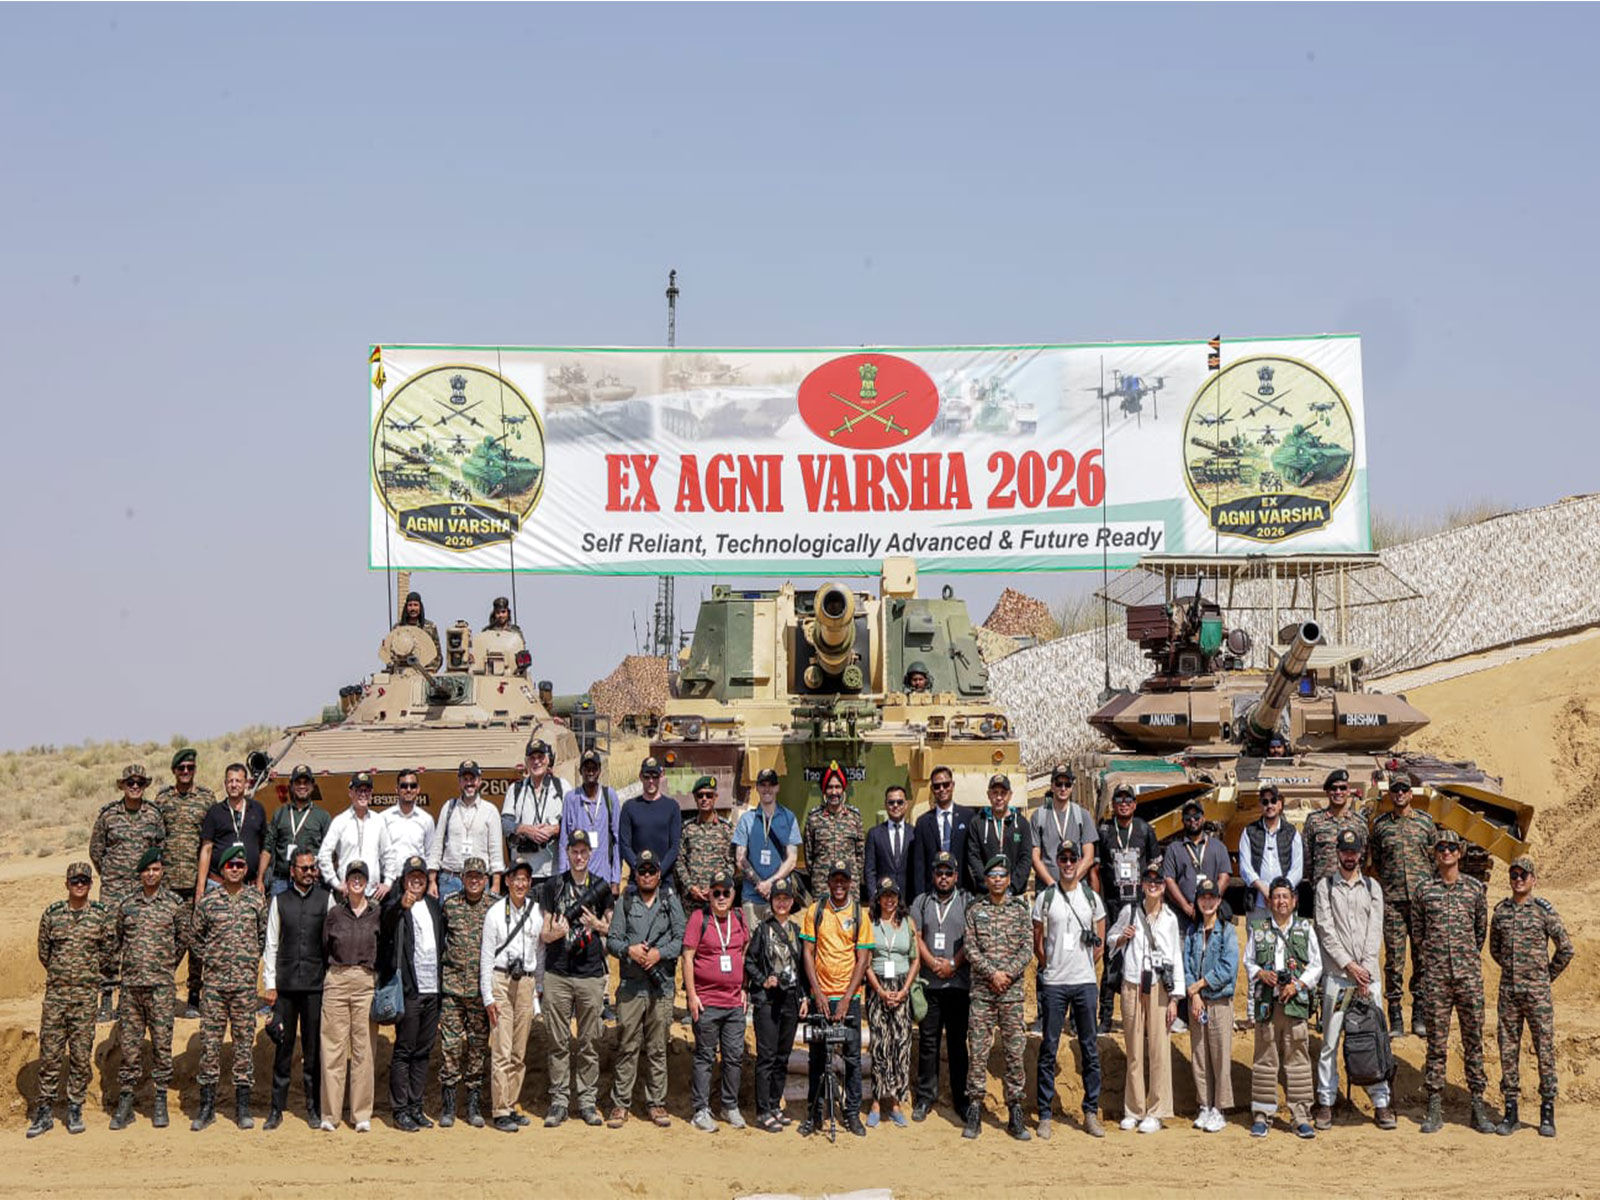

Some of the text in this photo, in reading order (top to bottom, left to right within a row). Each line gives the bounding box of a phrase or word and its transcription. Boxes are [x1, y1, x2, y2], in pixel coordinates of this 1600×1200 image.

[605, 449, 1106, 513] EX AGNI VARSHA 2026
[1261, 497, 1278, 507] EX
[450, 506, 467, 516] EX
[1218, 506, 1325, 526] AGNI VARSHA
[406, 516, 511, 534] AGNI VARSHA
[1256, 527, 1286, 537] 2026
[444, 535, 474, 546] 2026
[582, 526, 1163, 559] Self Reliant, Technologically Advanced & Future Ready
[1149, 714, 1176, 726] ANAND
